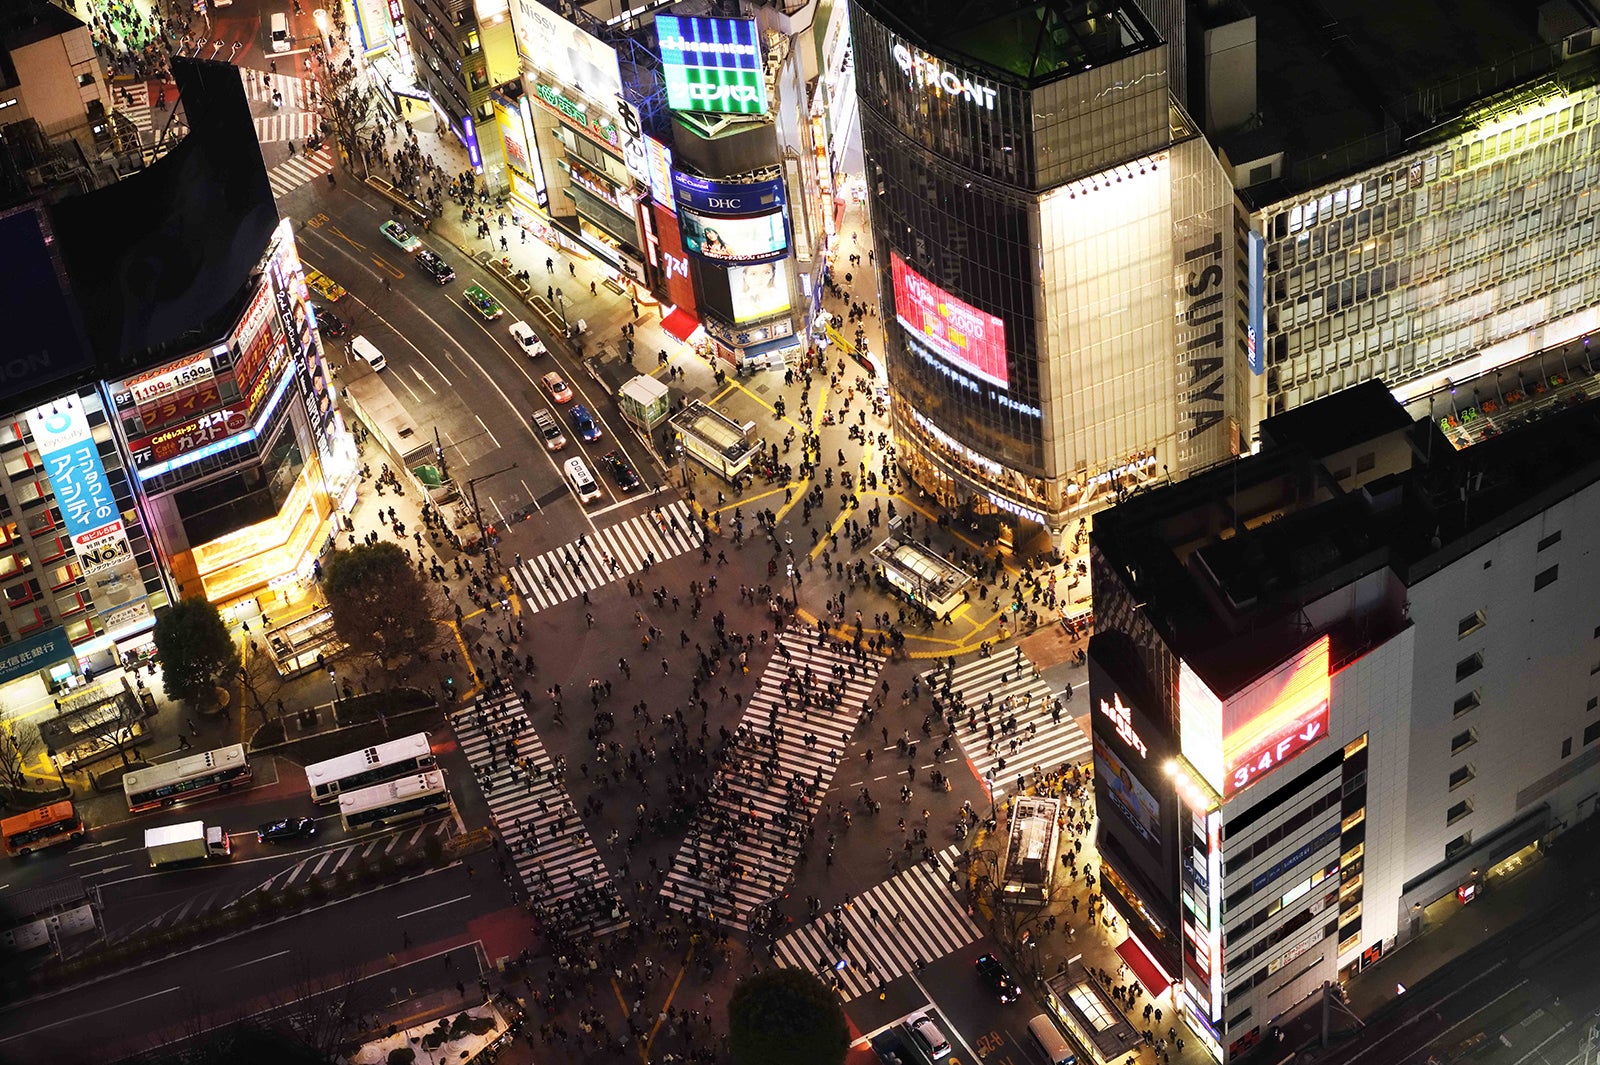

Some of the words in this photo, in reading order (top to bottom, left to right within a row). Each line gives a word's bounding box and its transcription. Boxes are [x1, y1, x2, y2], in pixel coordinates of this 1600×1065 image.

[893, 44, 996, 109] QFRONT
[616, 100, 648, 182] もんじ
[708, 197, 741, 209] DHC
[281, 311, 297, 348] Emotion
[1185, 232, 1224, 439] TSUTAYA
[116, 393, 131, 404] 9F
[305, 393, 321, 430] SUPER
[198, 410, 233, 429] ガスト
[178, 425, 222, 451] ガスト
[135, 450, 152, 463] 7F
[50, 454, 91, 525] アイシティ
[76, 447, 111, 518] コンタクトの
[988, 493, 1045, 525] TSUTAYA
[81, 538, 129, 569] No.1
